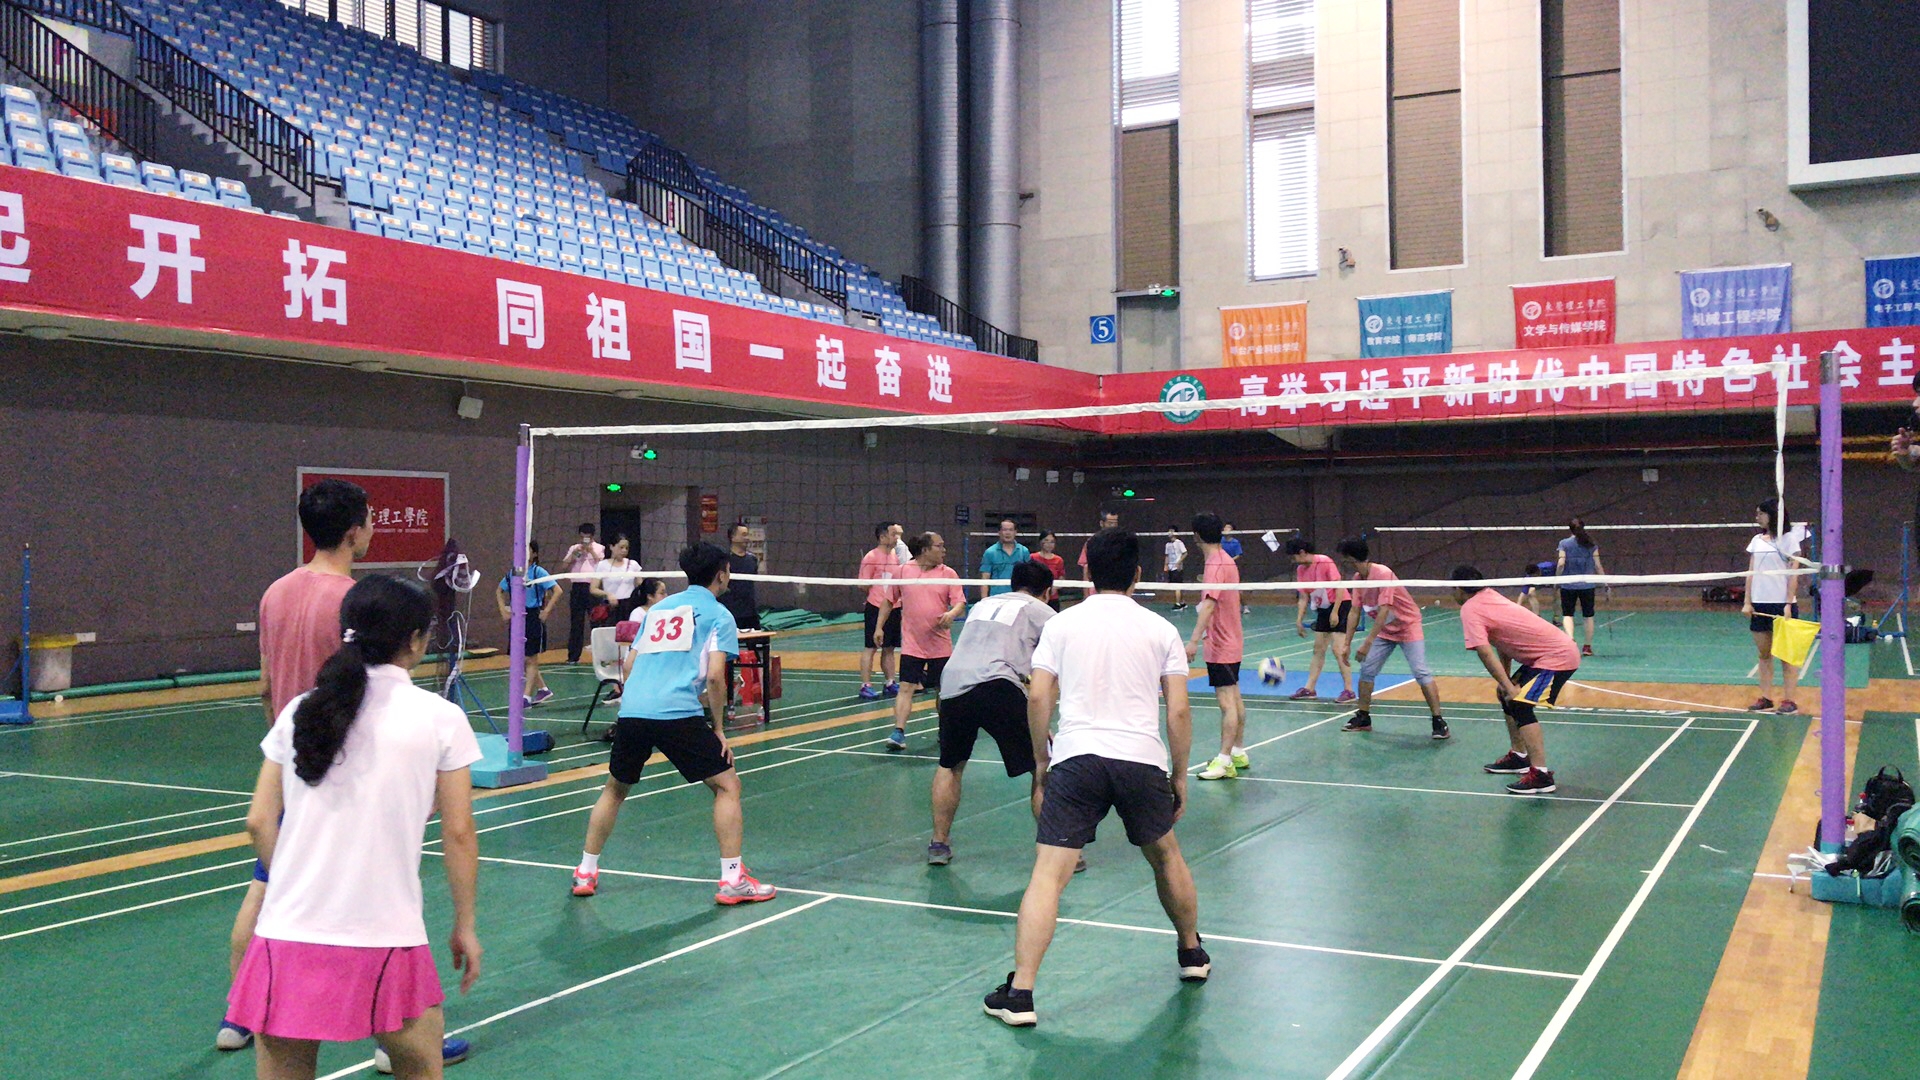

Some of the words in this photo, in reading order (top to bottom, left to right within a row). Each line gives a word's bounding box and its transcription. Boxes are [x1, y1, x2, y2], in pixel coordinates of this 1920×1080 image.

[1692, 307, 1781, 326] 机械工程学院
[1097, 320, 1109, 339] 5
[1523, 320, 1607, 336] 文学与传媒学院
[496, 278, 953, 403] 同祖国一起奋进
[1239, 337, 1916, 416] 高举习近平新时代中国特色社会主
[650, 616, 684, 642] 33
